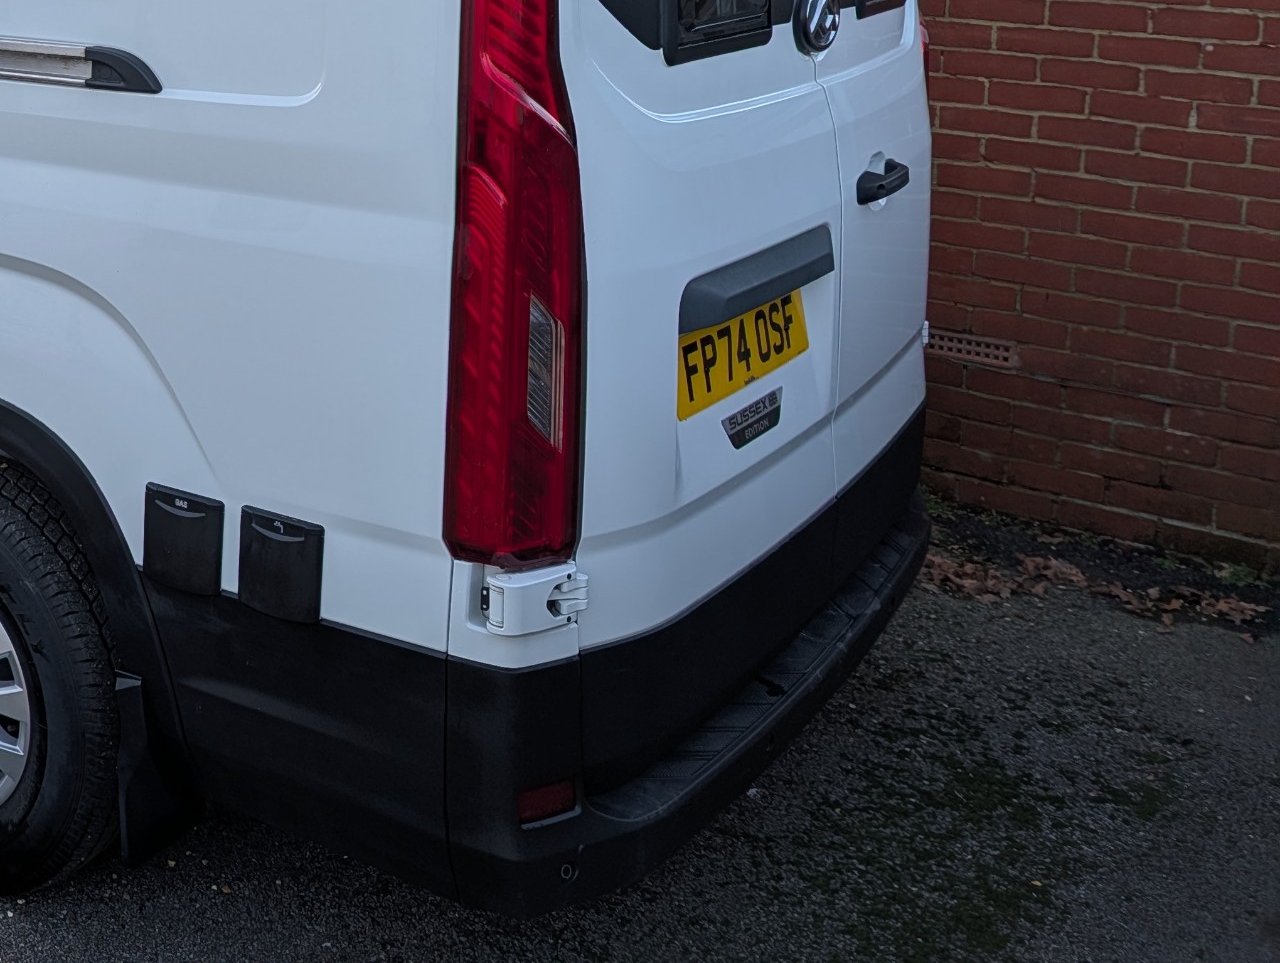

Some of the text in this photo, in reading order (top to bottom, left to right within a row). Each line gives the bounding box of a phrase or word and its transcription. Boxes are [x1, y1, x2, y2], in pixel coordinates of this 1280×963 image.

[681, 294, 793, 403] FP74 OSF
[728, 397, 768, 431] SUSSEX
[745, 418, 769, 439] EDITION
